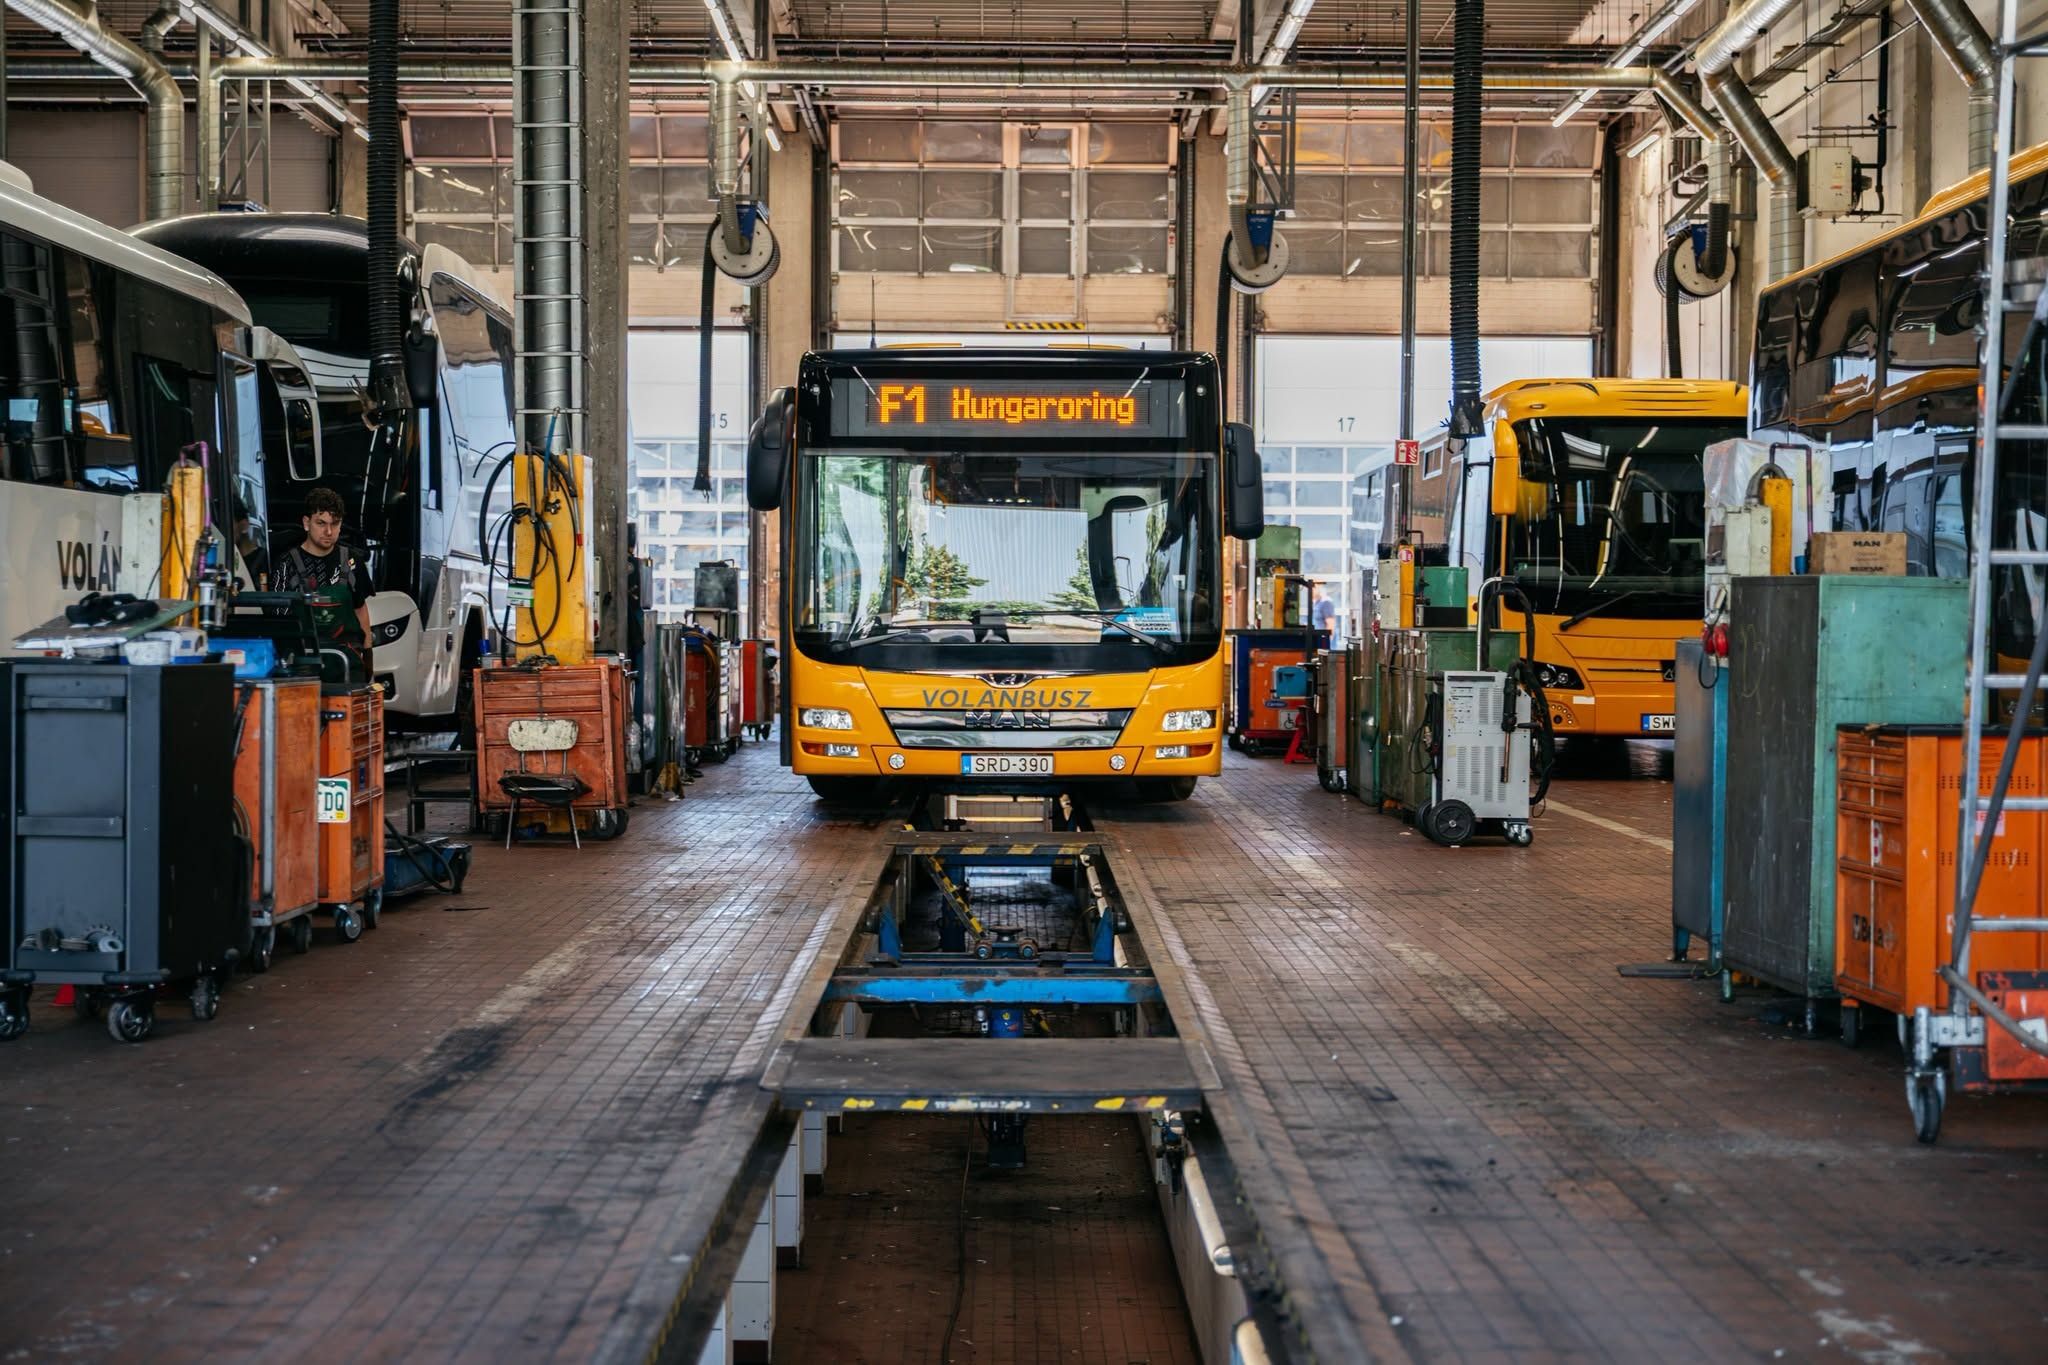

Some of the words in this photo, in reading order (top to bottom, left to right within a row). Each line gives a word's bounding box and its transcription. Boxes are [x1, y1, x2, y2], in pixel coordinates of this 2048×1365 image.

[880, 386, 924, 423] F1
[953, 388, 1135, 425] Hungaroring
[711, 413, 728, 429] 15
[1338, 417, 1355, 432] 17
[965, 709, 1050, 728] MAN
[975, 757, 1049, 772] SRD-390
